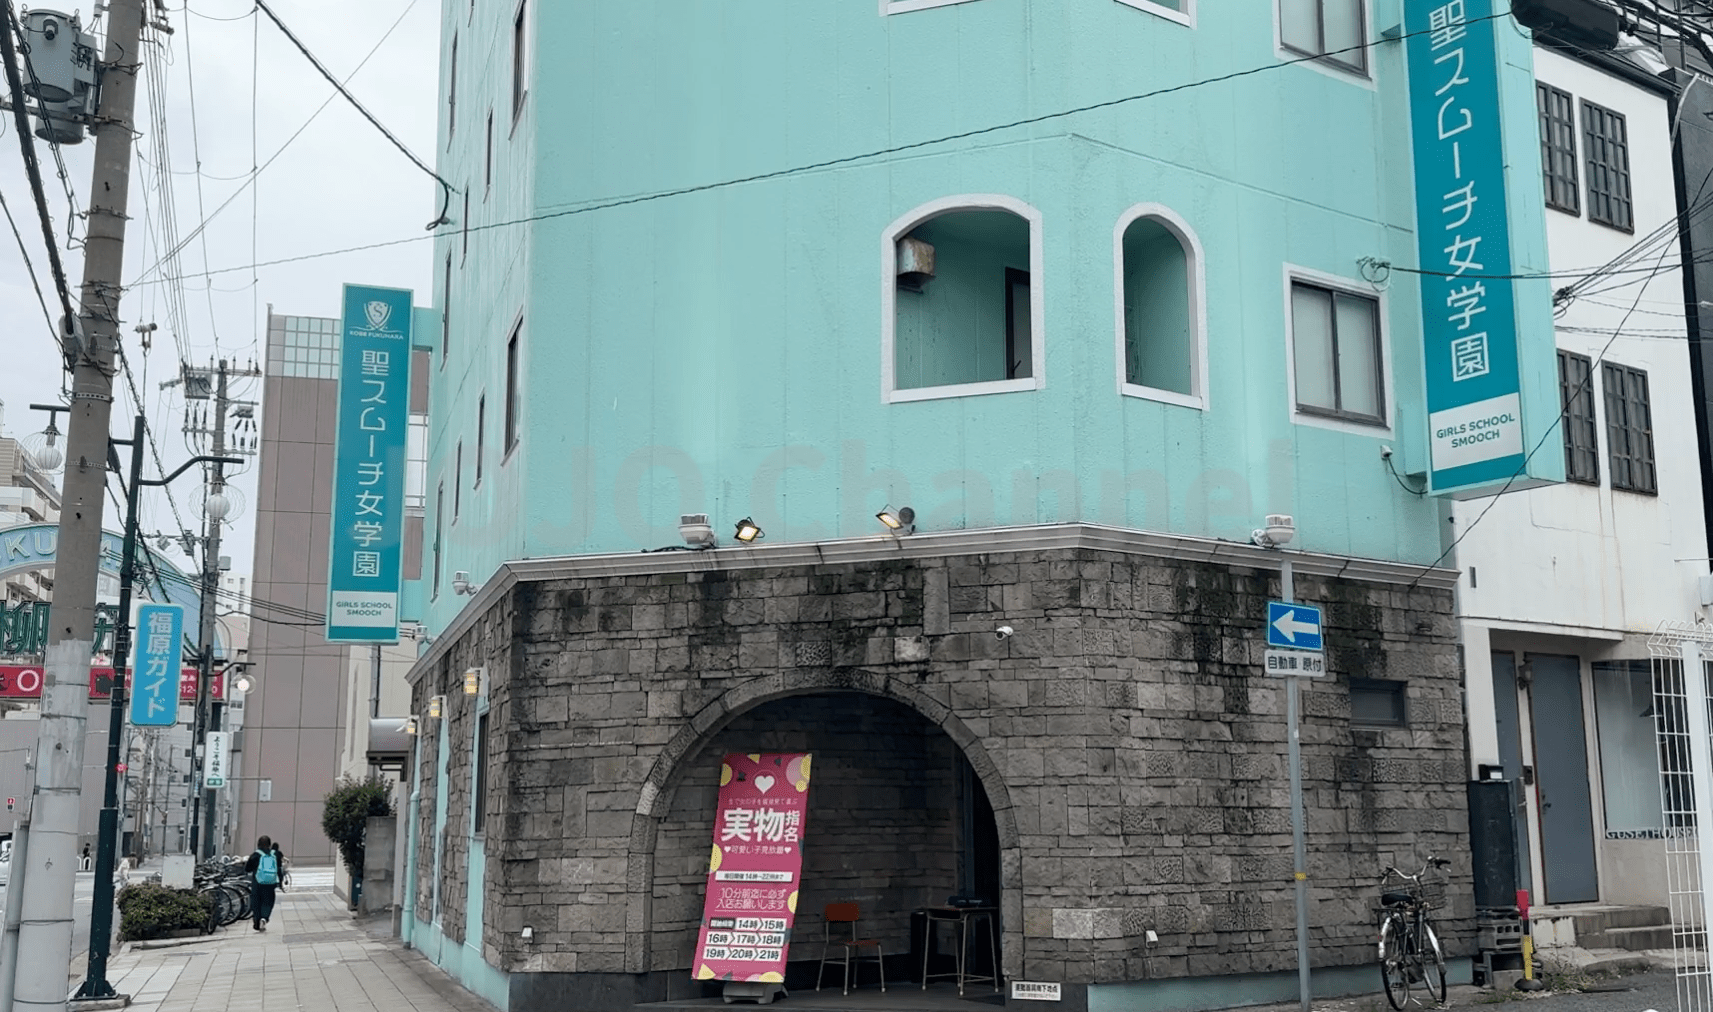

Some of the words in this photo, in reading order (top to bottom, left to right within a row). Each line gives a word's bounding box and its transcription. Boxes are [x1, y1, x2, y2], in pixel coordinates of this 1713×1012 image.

[1436, 424, 1466, 439] GIRLS
[1469, 413, 1515, 431] SCHOOL
[1451, 429, 1500, 448] SMOOCH
[353, 350, 389, 578] 聖スムーチ女学園
[336, 601, 358, 609] GIRLS
[361, 601, 392, 609] SCHOOL
[144, 611, 173, 718] 福原ガイド
[1268, 655, 1297, 669] 自動車
[1303, 656, 1322, 672] 原付
[715, 898, 786, 910] 入店お願いします
[738, 919, 758, 930] 14時
[764, 919, 784, 930] 15時
[708, 933, 728, 943] 16時
[736, 934, 756, 944] 17時
[762, 934, 782, 945] 18時
[706, 948, 726, 958] 19時
[731, 949, 753, 959] 20時
[758, 949, 779, 960] 21時
